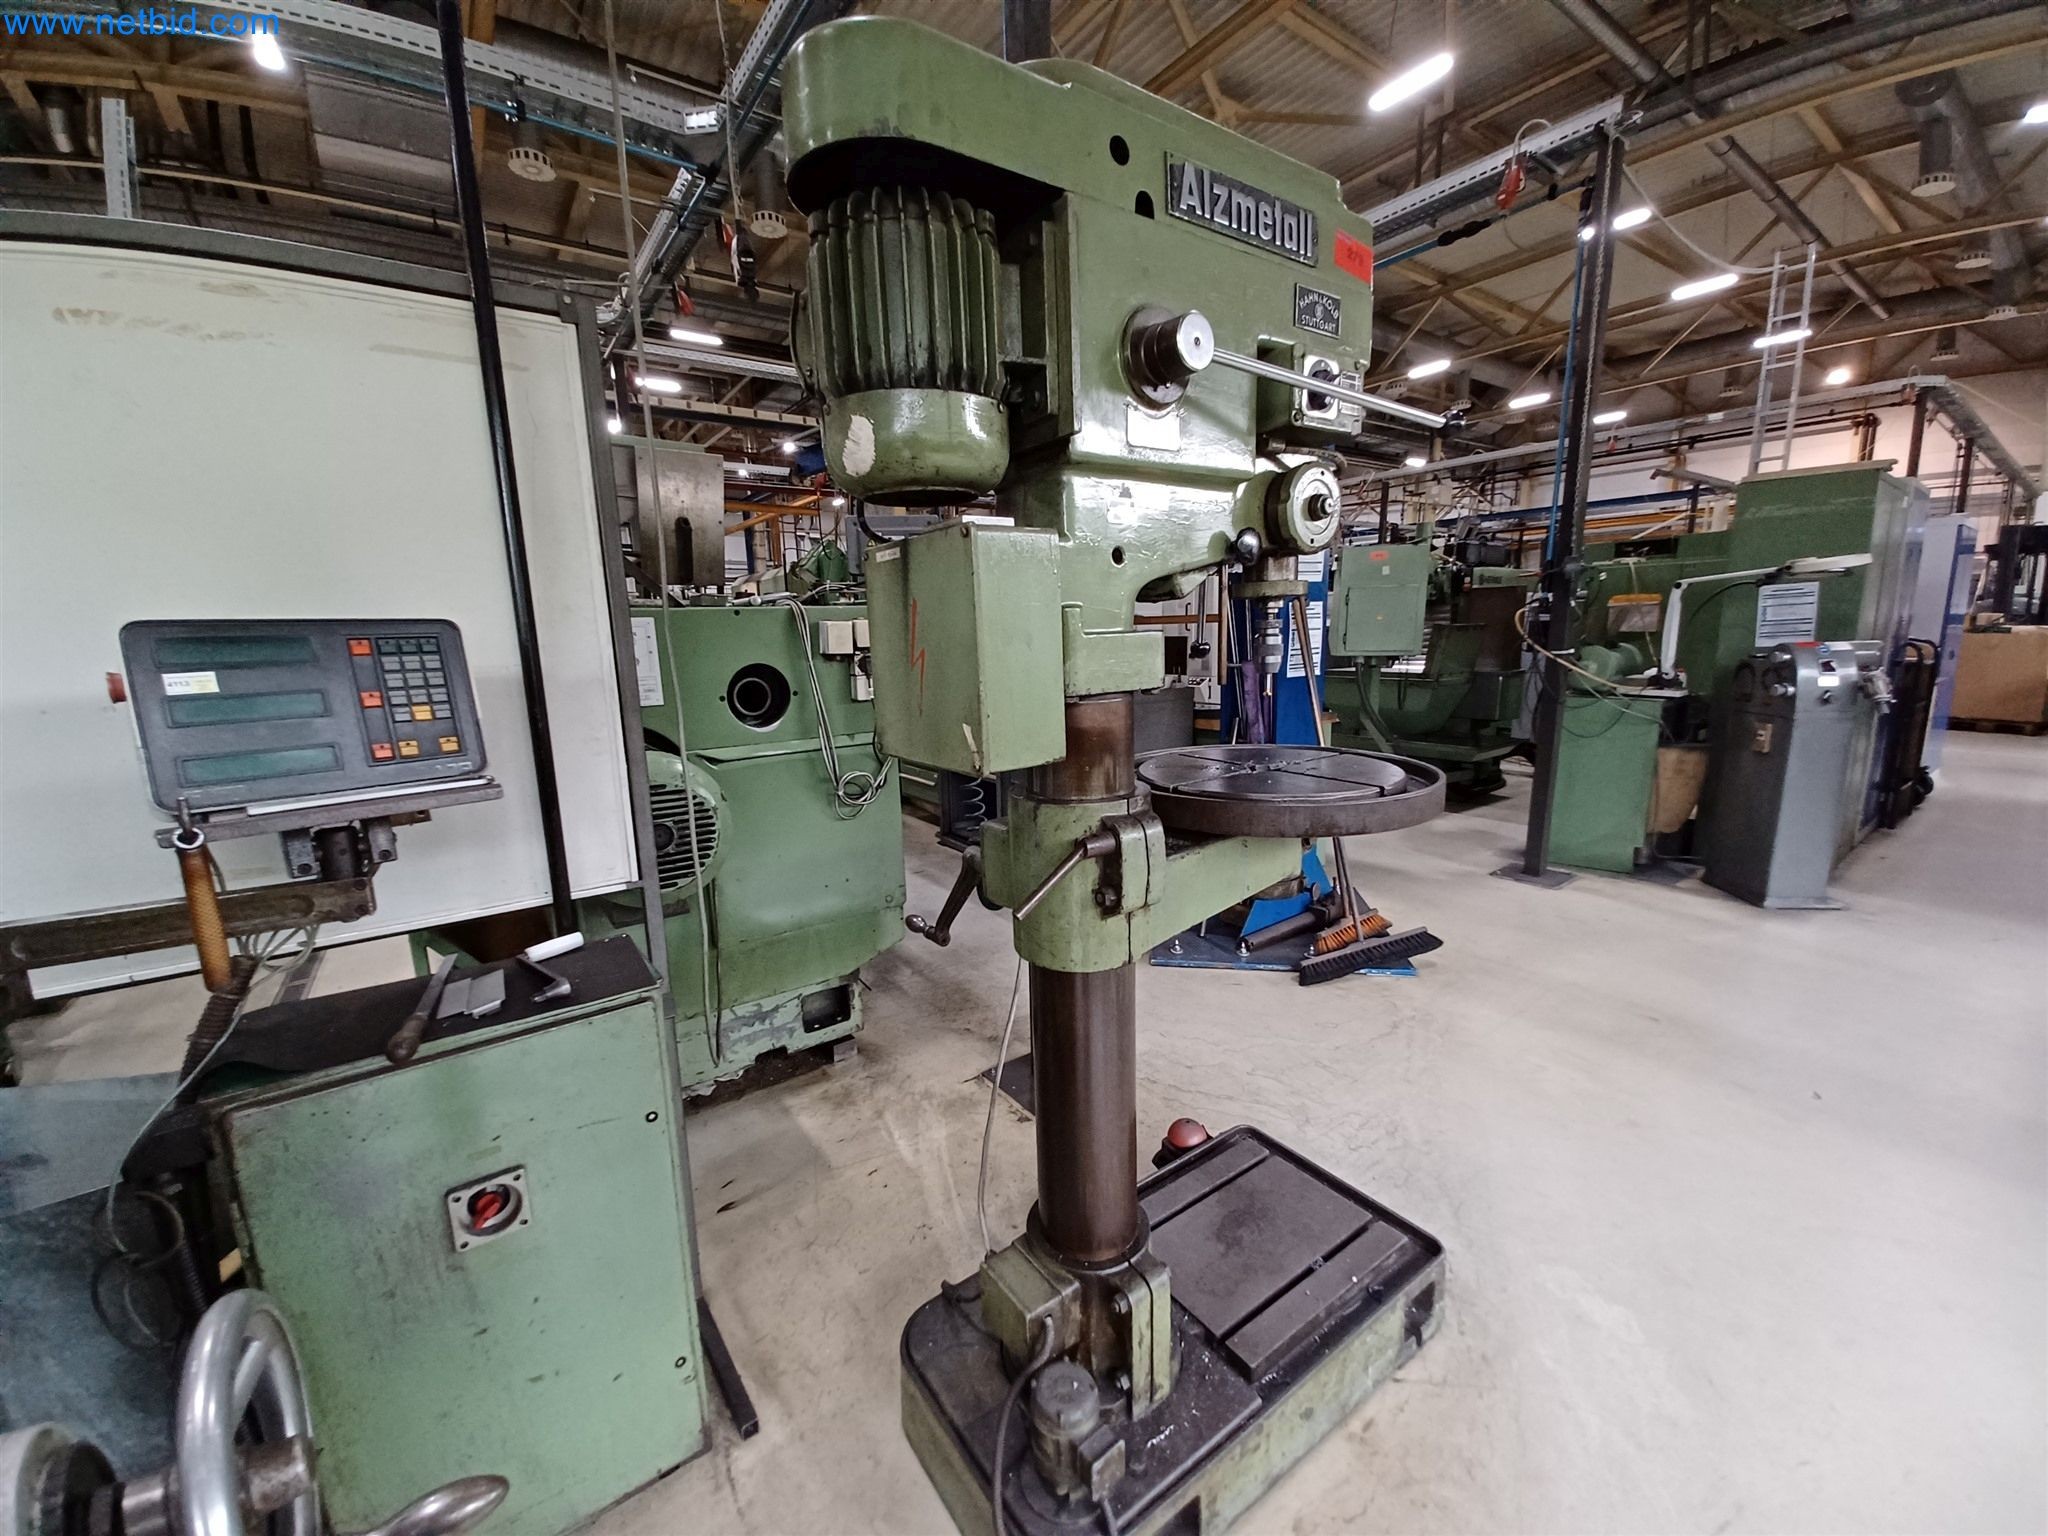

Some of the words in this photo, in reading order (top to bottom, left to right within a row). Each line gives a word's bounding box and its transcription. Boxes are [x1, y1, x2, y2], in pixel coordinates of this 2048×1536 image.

[1179, 161, 1313, 257] Alzmetall
[1299, 292, 1319, 309] HAHN
[1322, 295, 1339, 319] KOLB
[1301, 314, 1336, 333] STUTTGART
